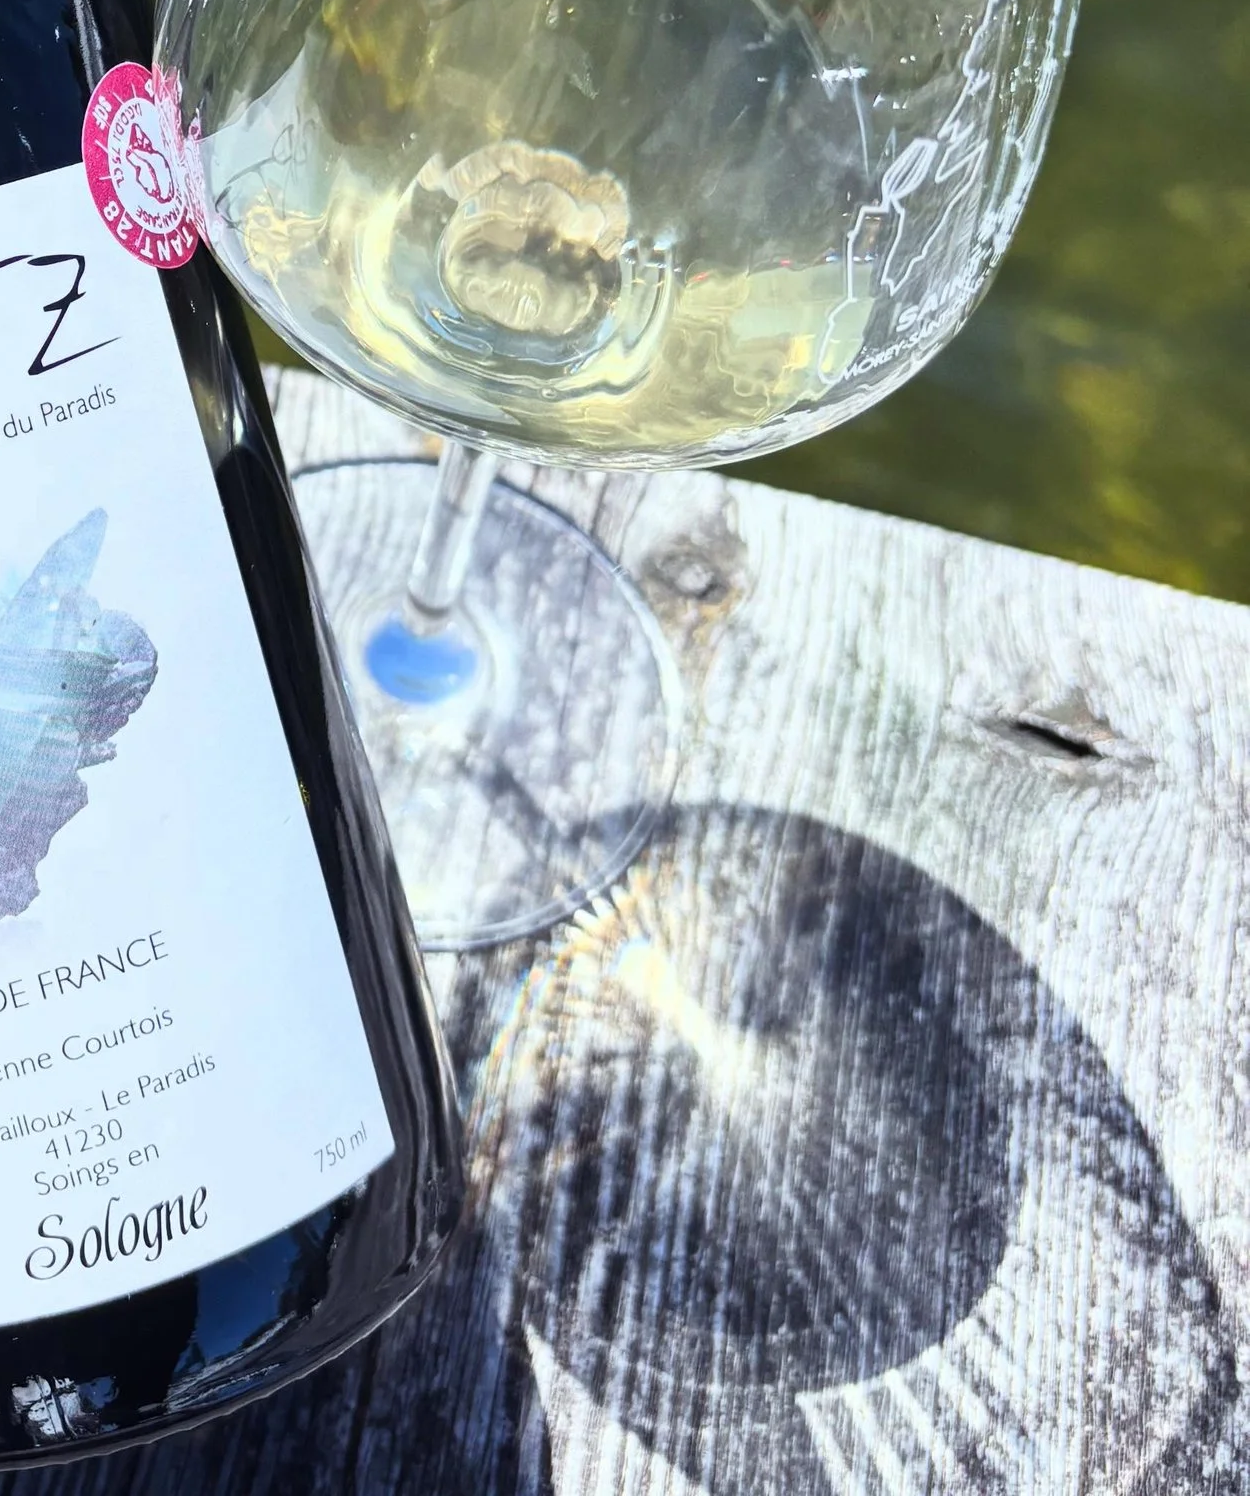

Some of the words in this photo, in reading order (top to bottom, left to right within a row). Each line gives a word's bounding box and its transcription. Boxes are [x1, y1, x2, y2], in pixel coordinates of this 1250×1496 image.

[2, 413, 34, 439] du
[39, 383, 117, 427] Paradis
[37, 929, 169, 1001] FRANCE
[61, 1006, 174, 1061] Courtois
[101, 1089, 131, 1112] Le
[137, 1052, 216, 1099] Paradis
[44, 1118, 123, 1160] 41230
[313, 1137, 346, 1173] 750
[349, 1120, 368, 1151] ml
[33, 1157, 119, 1196] Soings
[127, 1143, 160, 1167] en
[26, 1185, 209, 1281] Sologne
